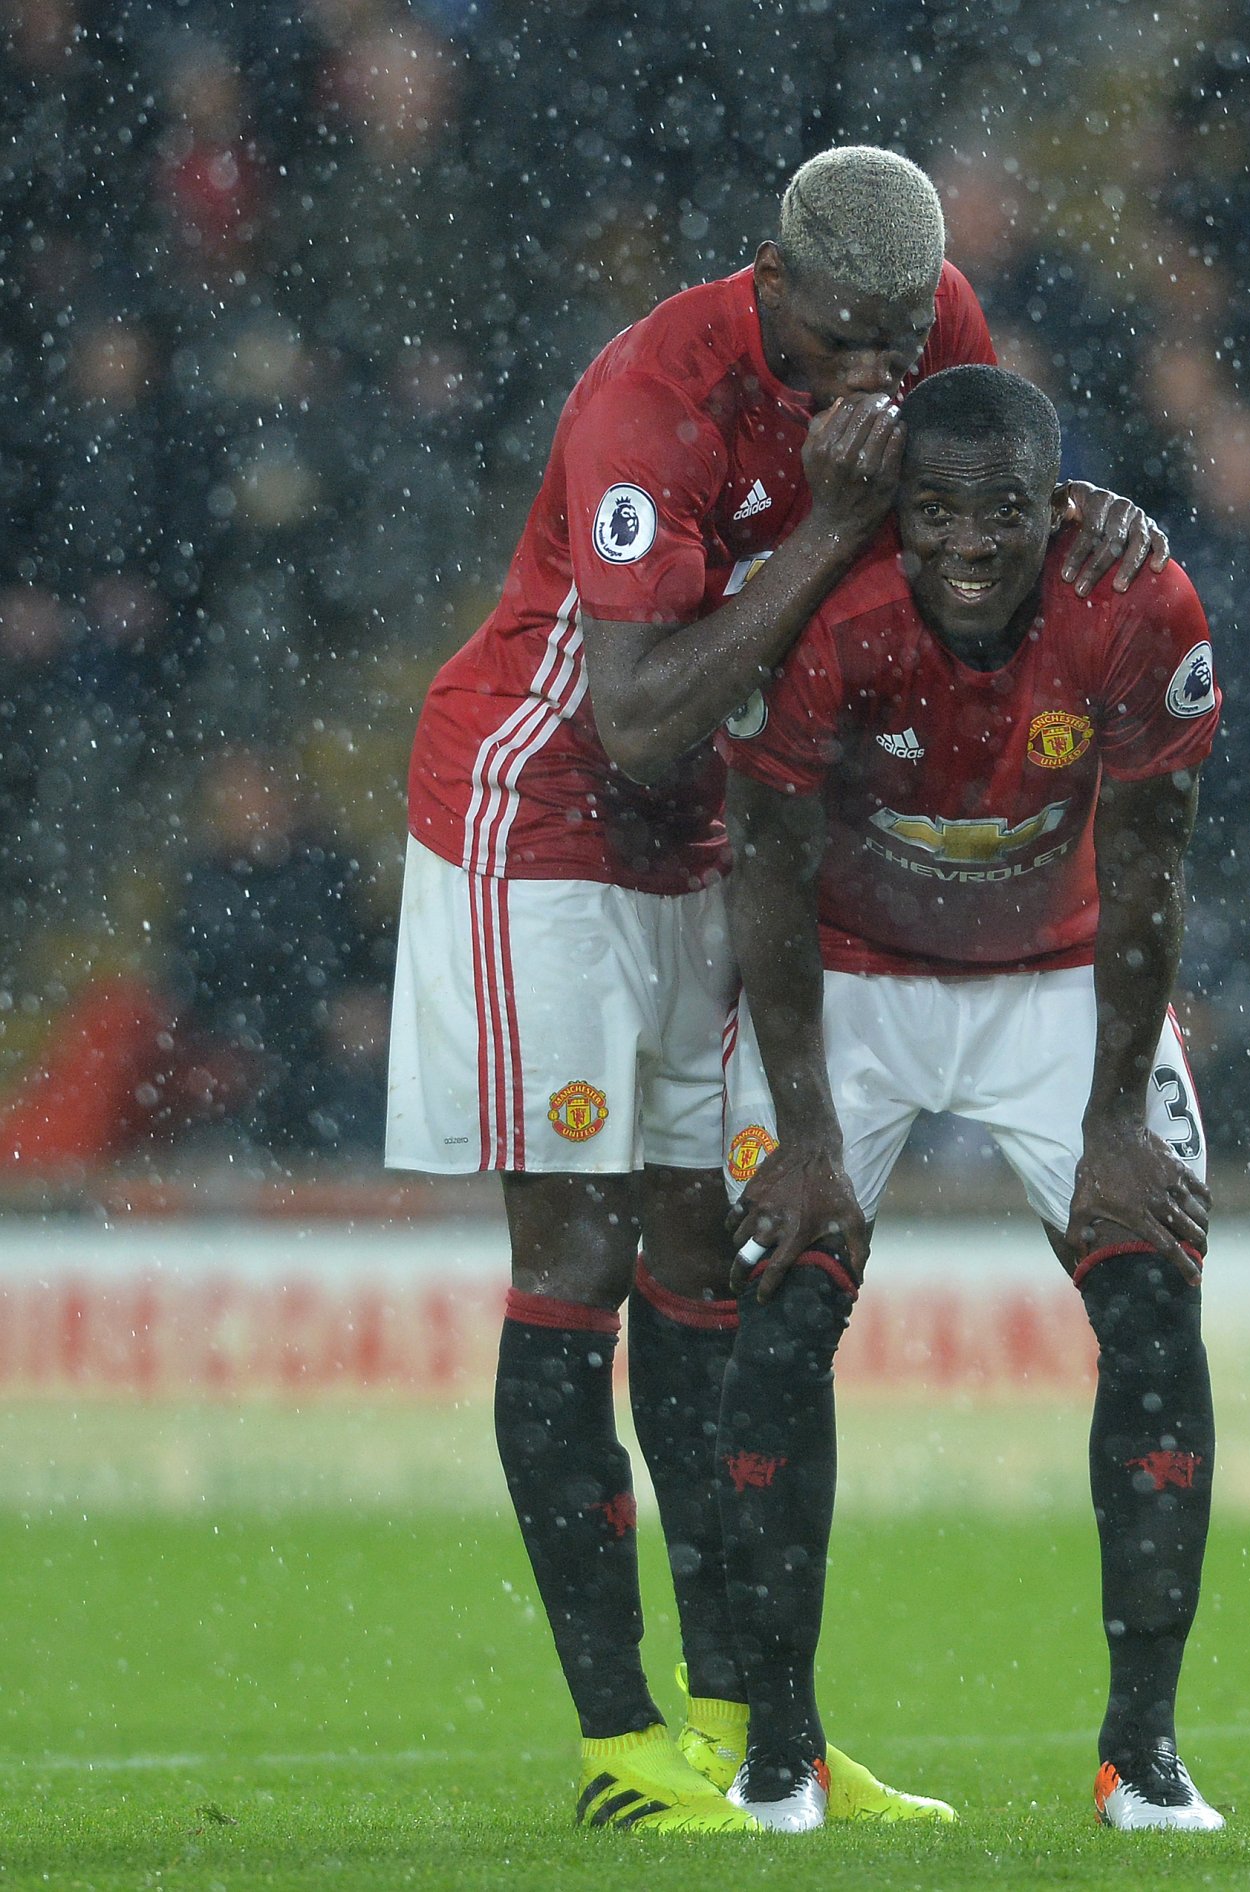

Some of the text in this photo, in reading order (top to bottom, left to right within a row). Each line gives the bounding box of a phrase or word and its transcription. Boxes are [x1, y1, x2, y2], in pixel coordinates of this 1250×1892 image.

[733, 497, 772, 520] adidas
[1029, 715, 1085, 737] MANCHESTER
[876, 735, 925, 759] adidas
[1040, 749, 1082, 765] UNITED
[866, 836, 1074, 883] CHEVROLET
[554, 1085, 602, 1106] MANCHESTER
[562, 1126, 596, 1138] UNITED
